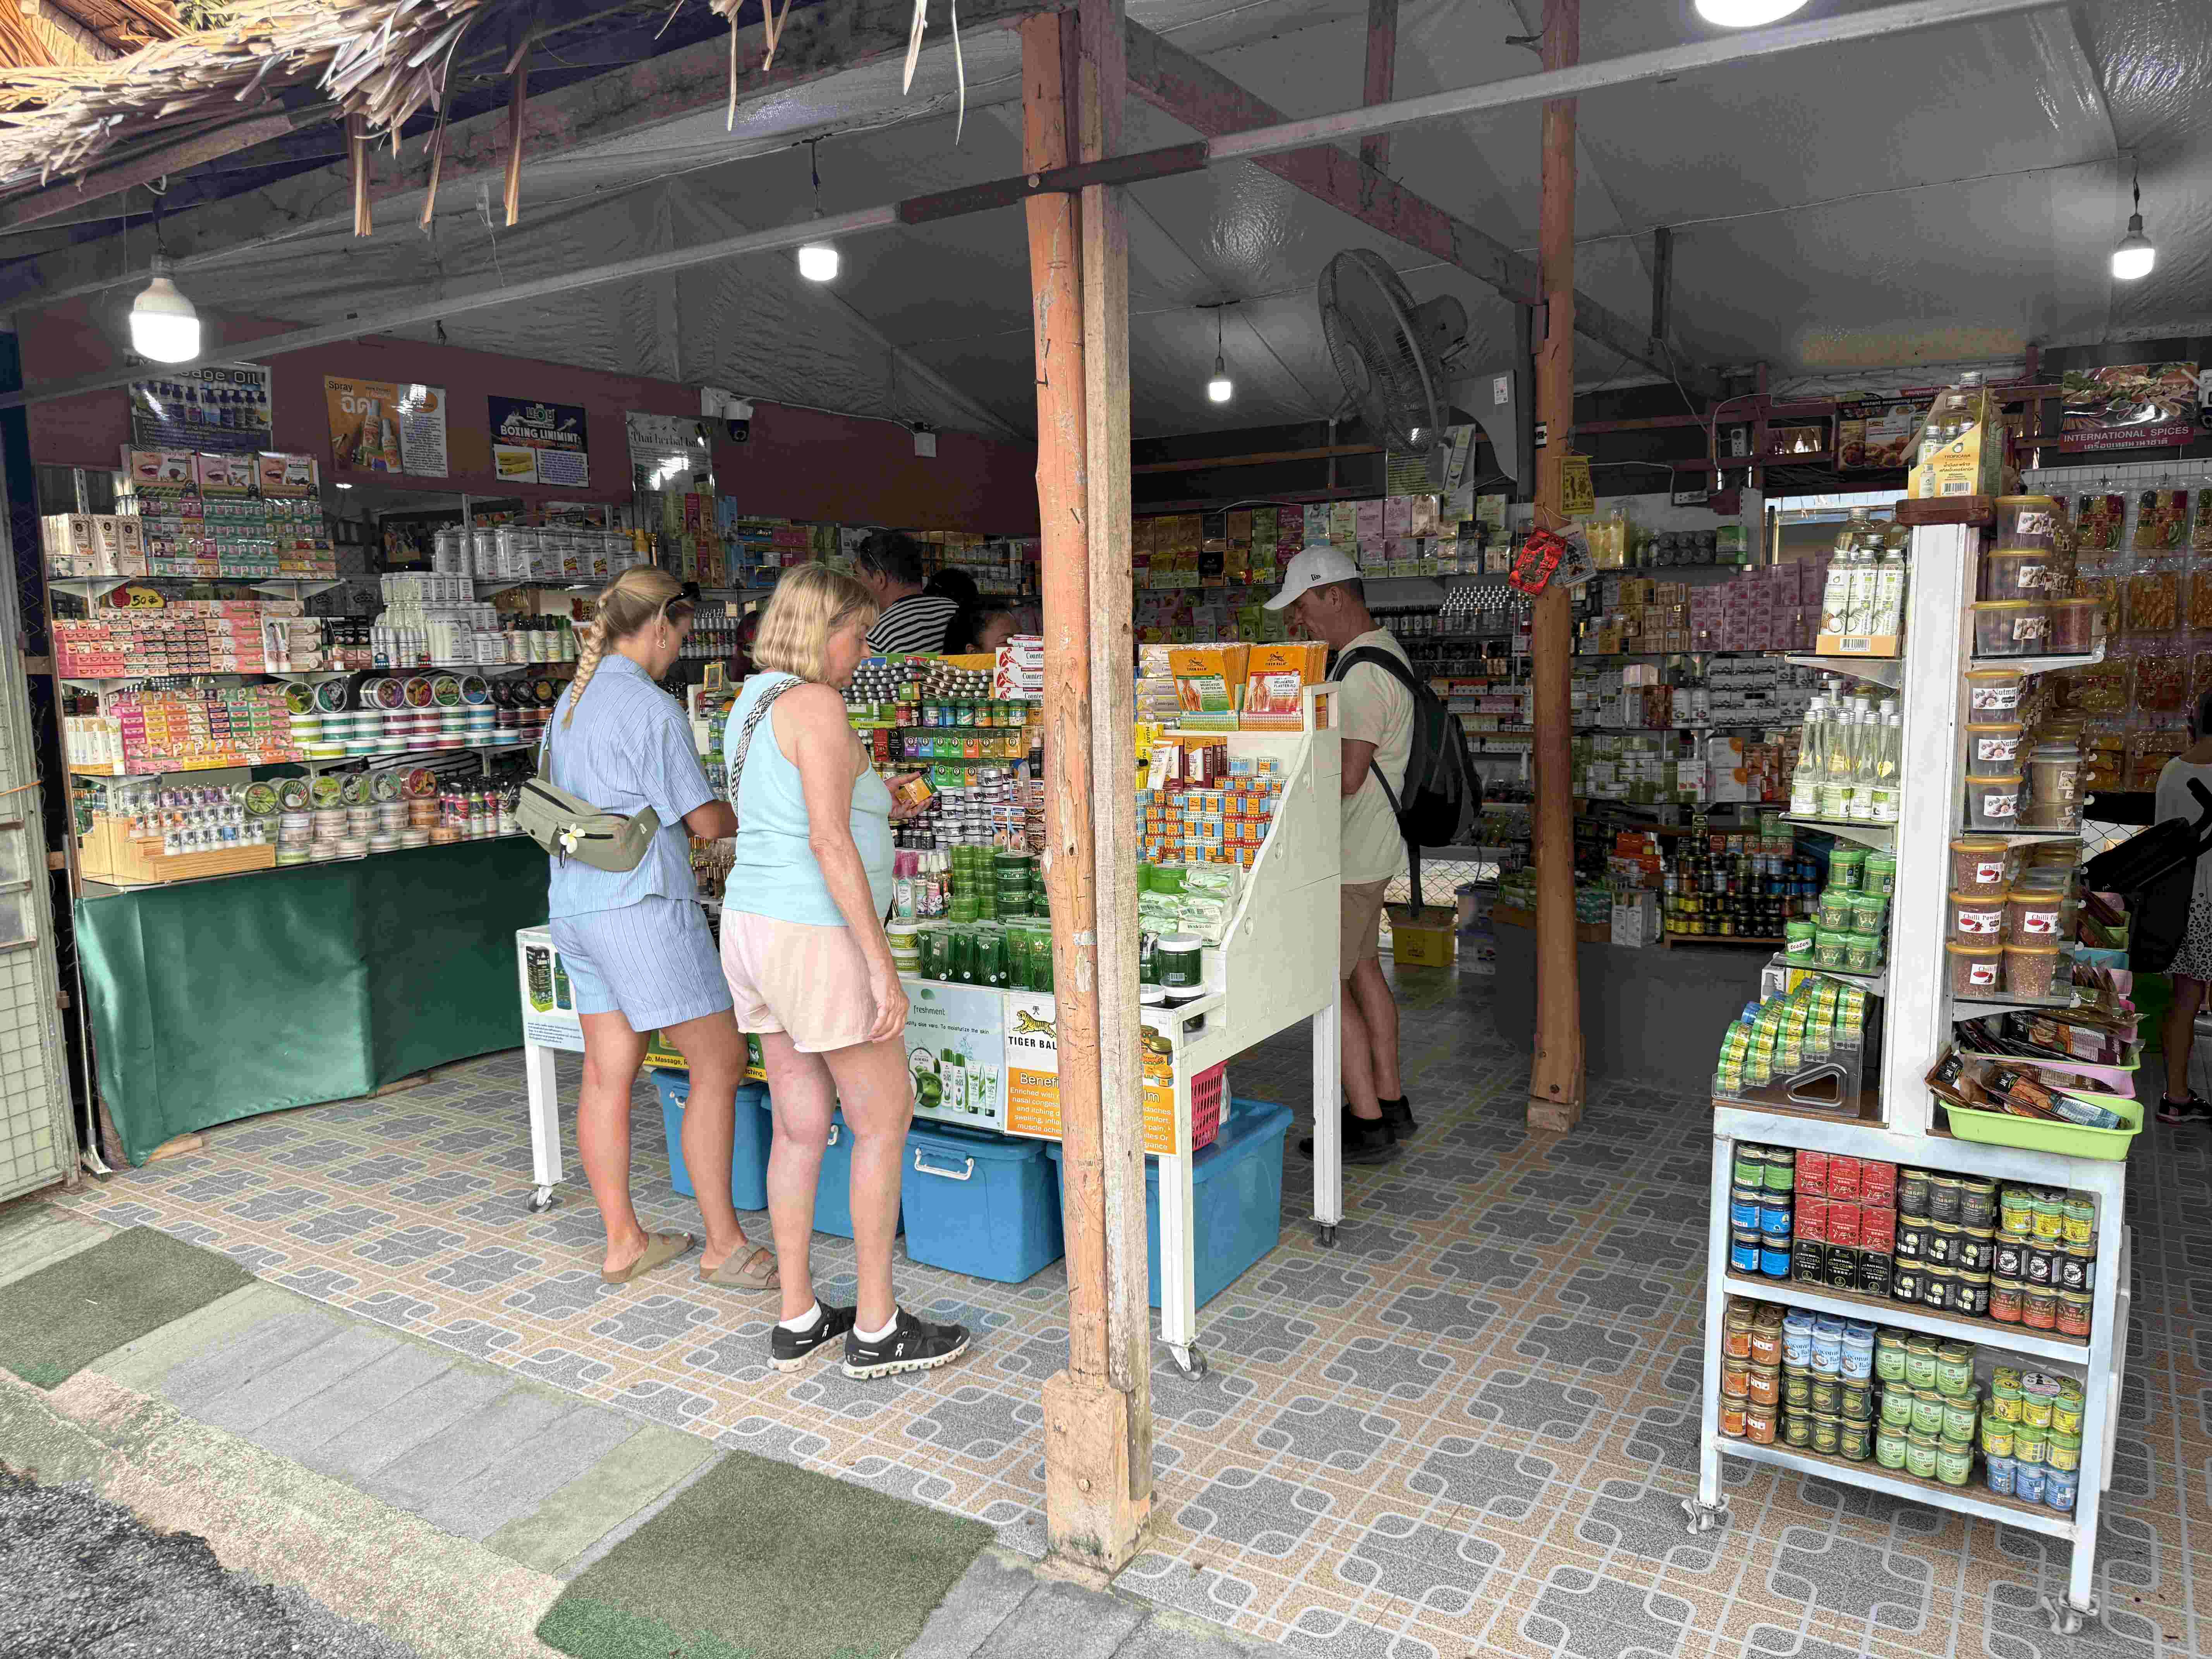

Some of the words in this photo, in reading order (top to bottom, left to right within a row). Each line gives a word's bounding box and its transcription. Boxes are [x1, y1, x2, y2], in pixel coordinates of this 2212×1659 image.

[328, 380, 353, 392] Spray
[500, 424, 538, 438] BOXING
[540, 429, 577, 443] LINIMINT
[631, 431, 653, 443] Thai
[655, 433, 683, 447] herbal
[2064, 429, 2146, 442] INTERNATIONAL
[2150, 426, 2189, 436] SPICES
[914, 1005, 945, 1016] freshment
[1008, 1036, 1036, 1048] TIGER
[1039, 1040, 1057, 1050] BAL
[1020, 1072, 1060, 1088] Benefi
[1010, 1087, 1039, 1096] Enriched
[1144, 1089, 1160, 1103] lm
[1031, 1107, 1054, 1116] itching
[1144, 1132, 1158, 1141] ites
